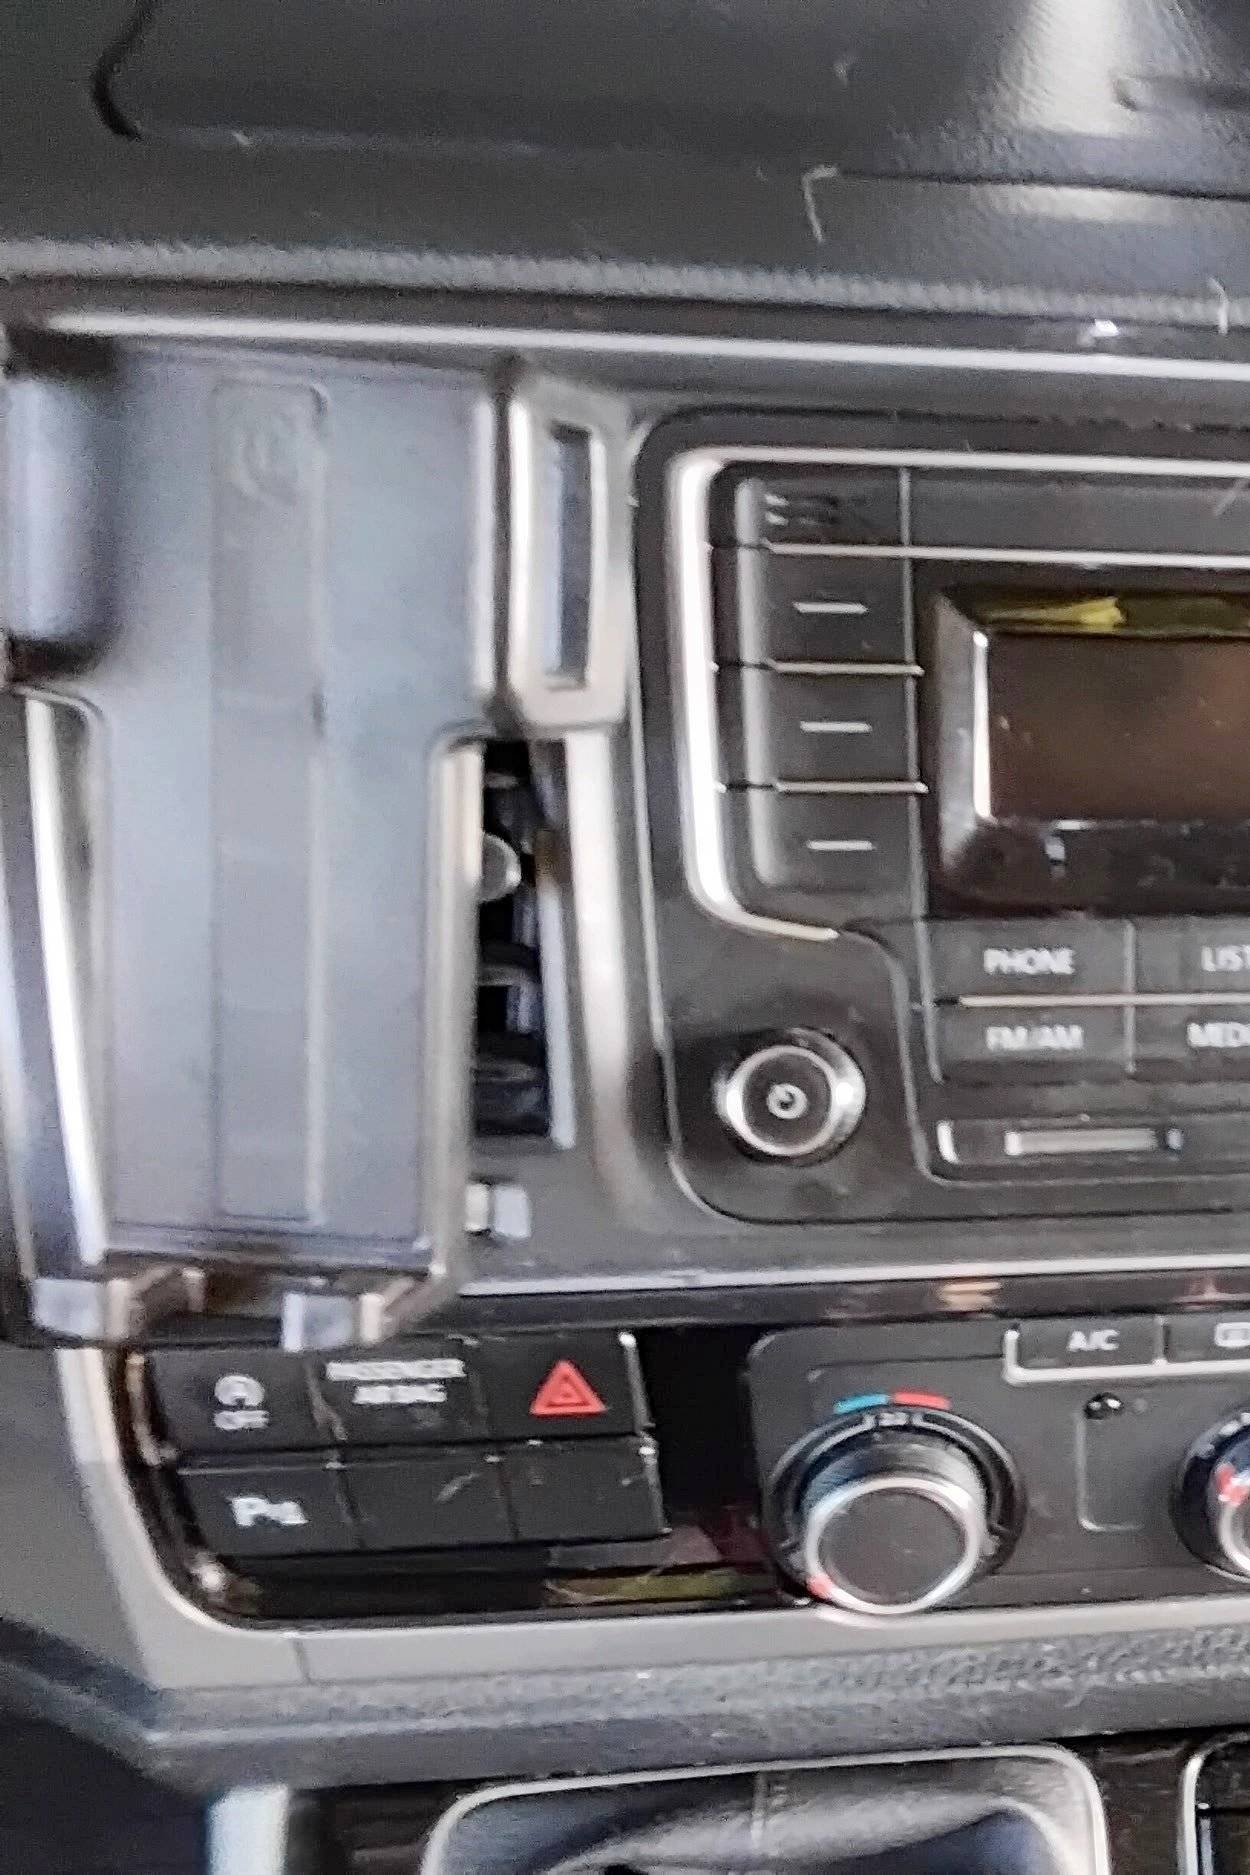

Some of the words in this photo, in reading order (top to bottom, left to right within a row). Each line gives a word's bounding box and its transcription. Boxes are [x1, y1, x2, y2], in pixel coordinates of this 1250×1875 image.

[984, 949, 1075, 974] PHONE
[985, 1025, 1084, 1050] FM/AM
[1067, 1329, 1119, 1351] A/C
